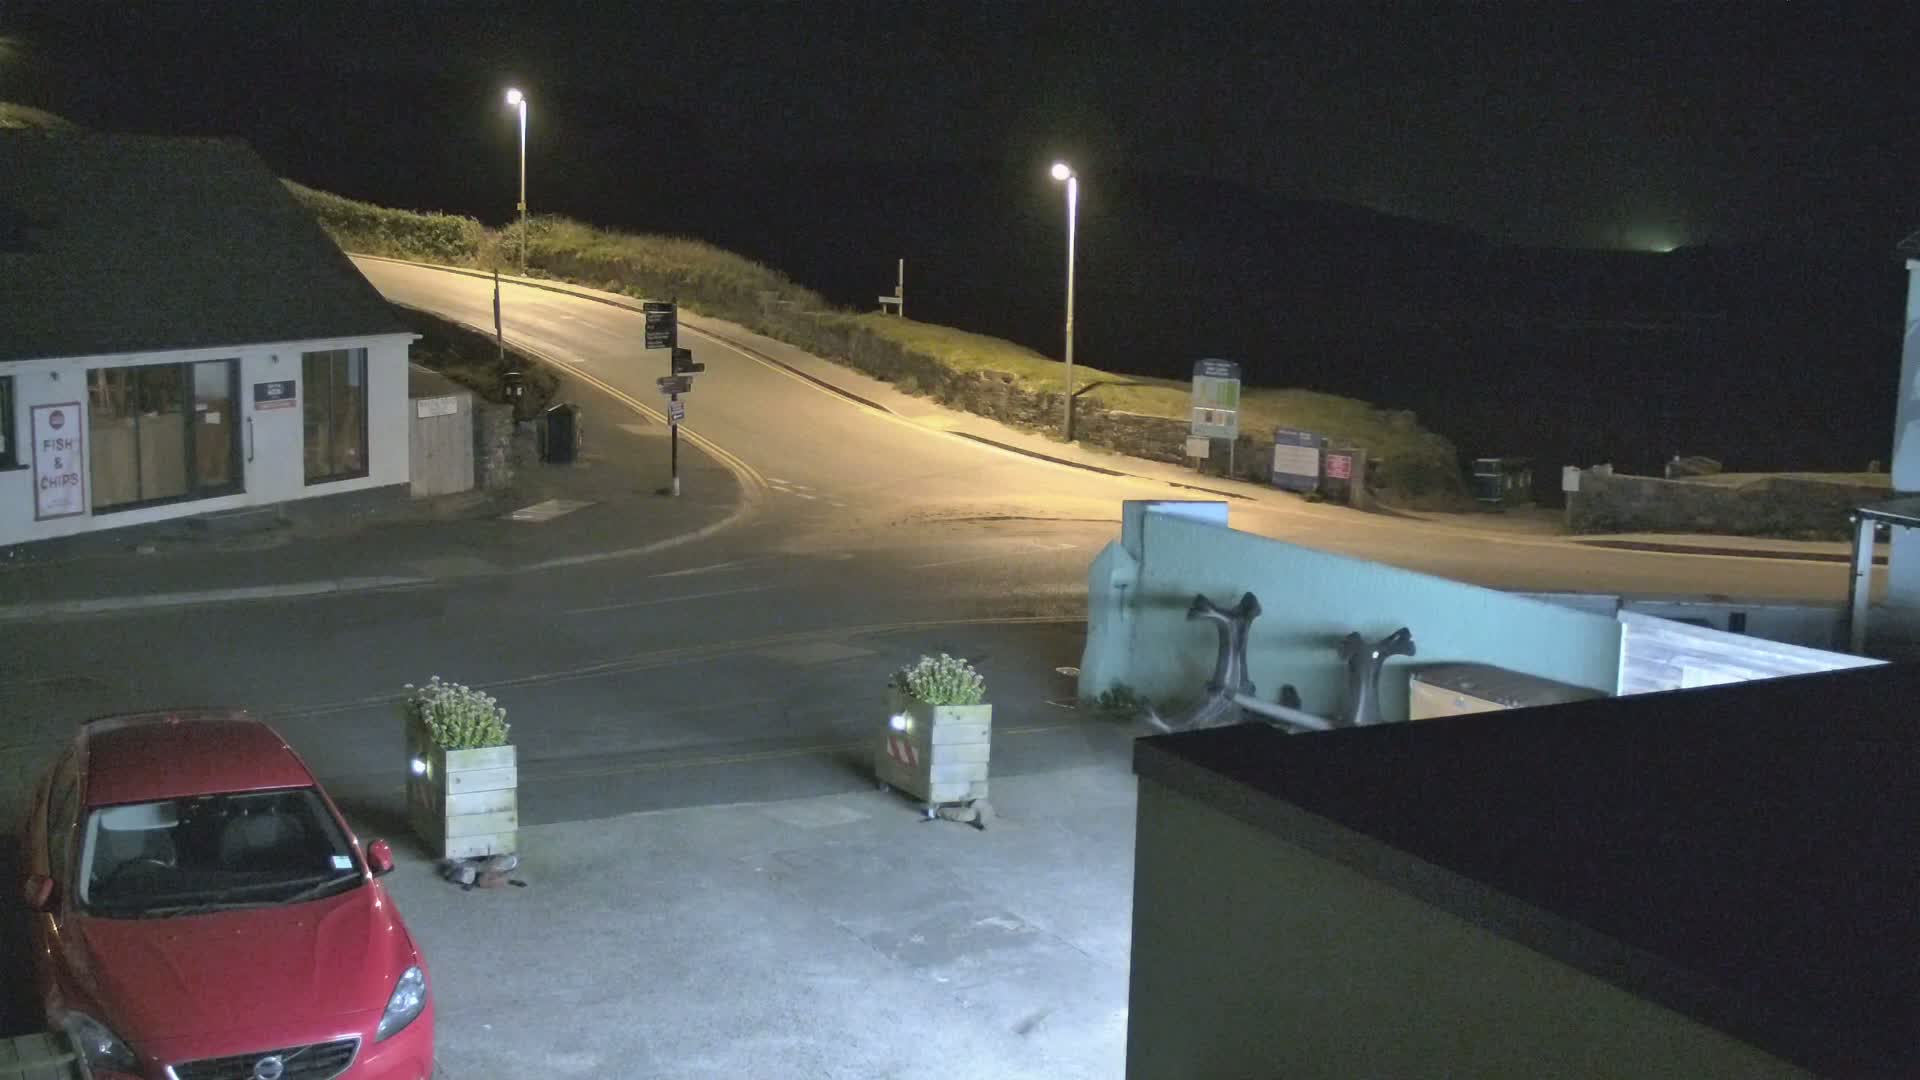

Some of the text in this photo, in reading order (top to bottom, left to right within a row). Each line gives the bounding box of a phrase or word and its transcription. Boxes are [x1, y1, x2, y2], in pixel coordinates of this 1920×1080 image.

[43, 438, 73, 452] FISH
[54, 457, 63, 470] &
[40, 473, 79, 490] CHIPS
